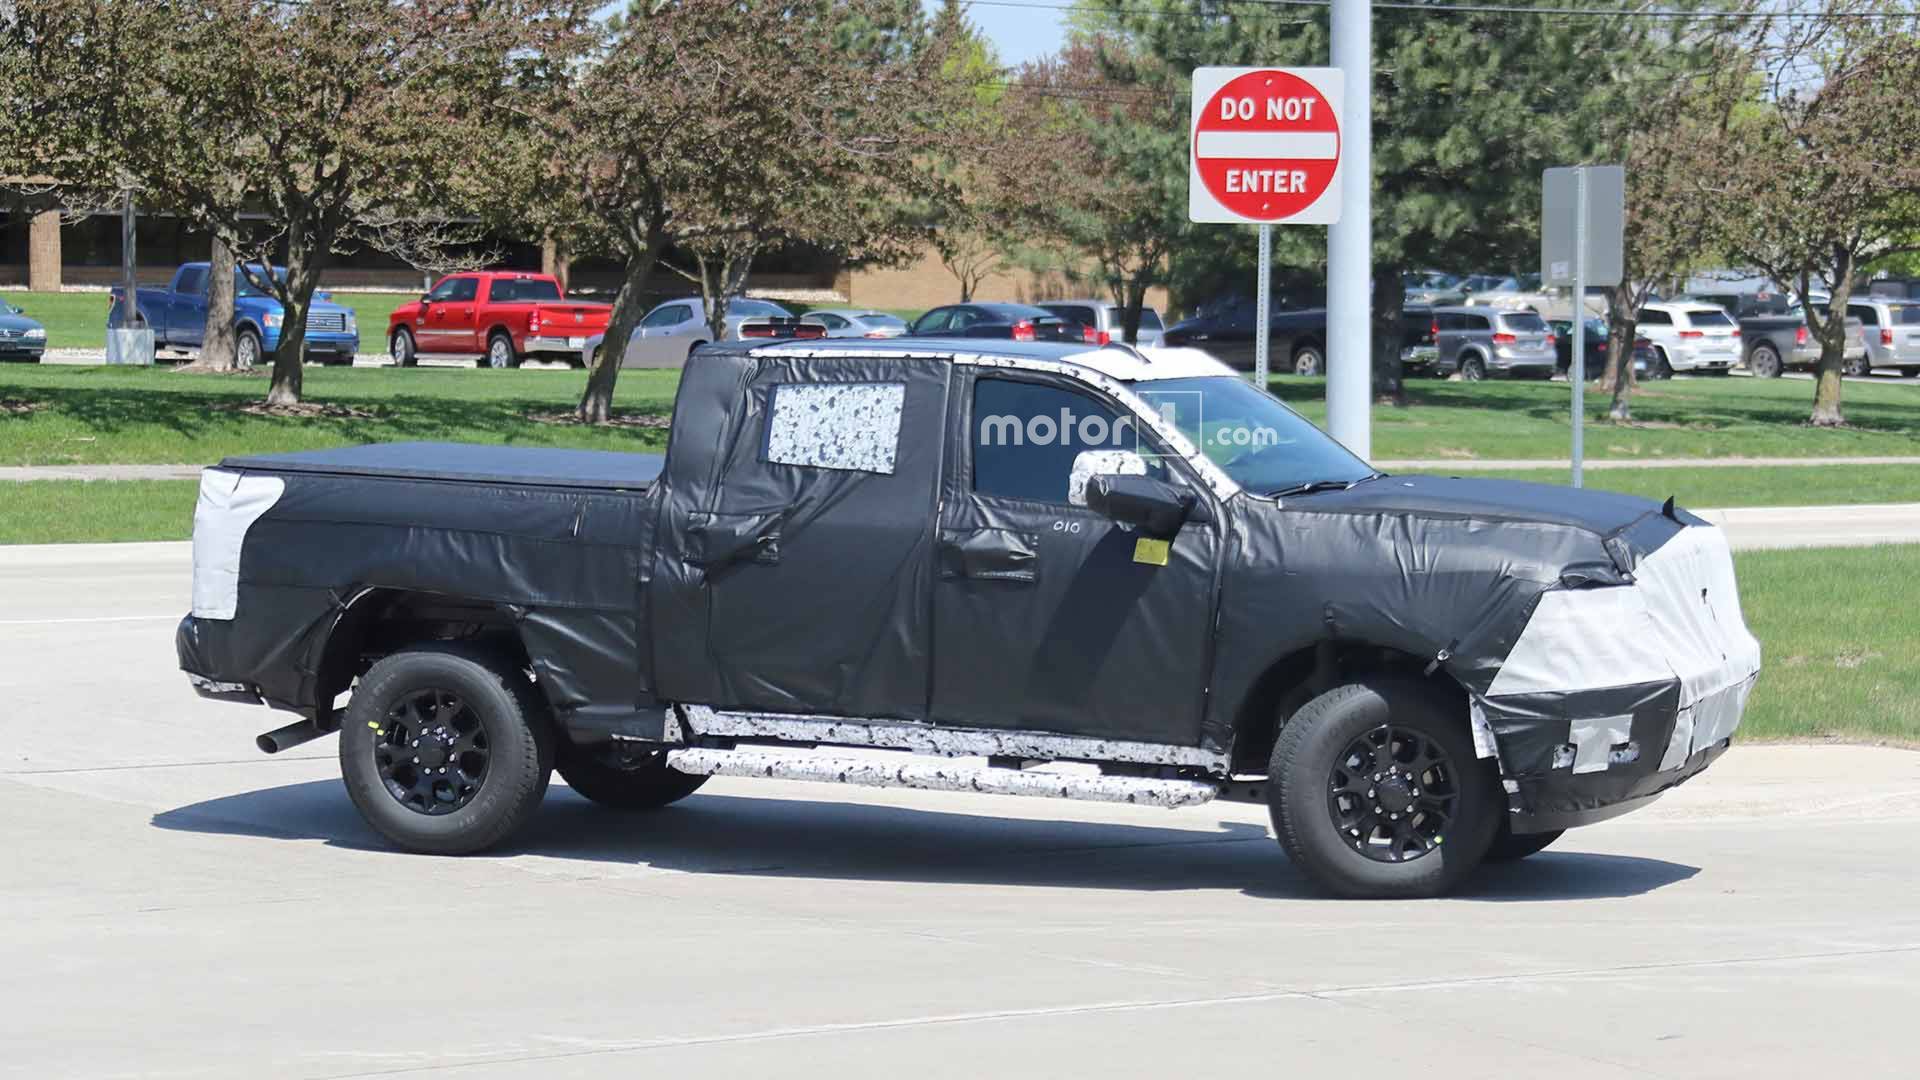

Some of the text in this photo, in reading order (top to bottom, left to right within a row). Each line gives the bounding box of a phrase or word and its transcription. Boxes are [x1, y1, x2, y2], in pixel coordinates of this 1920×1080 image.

[1220, 97, 1315, 121] DO NOT
[1226, 169, 1307, 193] ENTER
